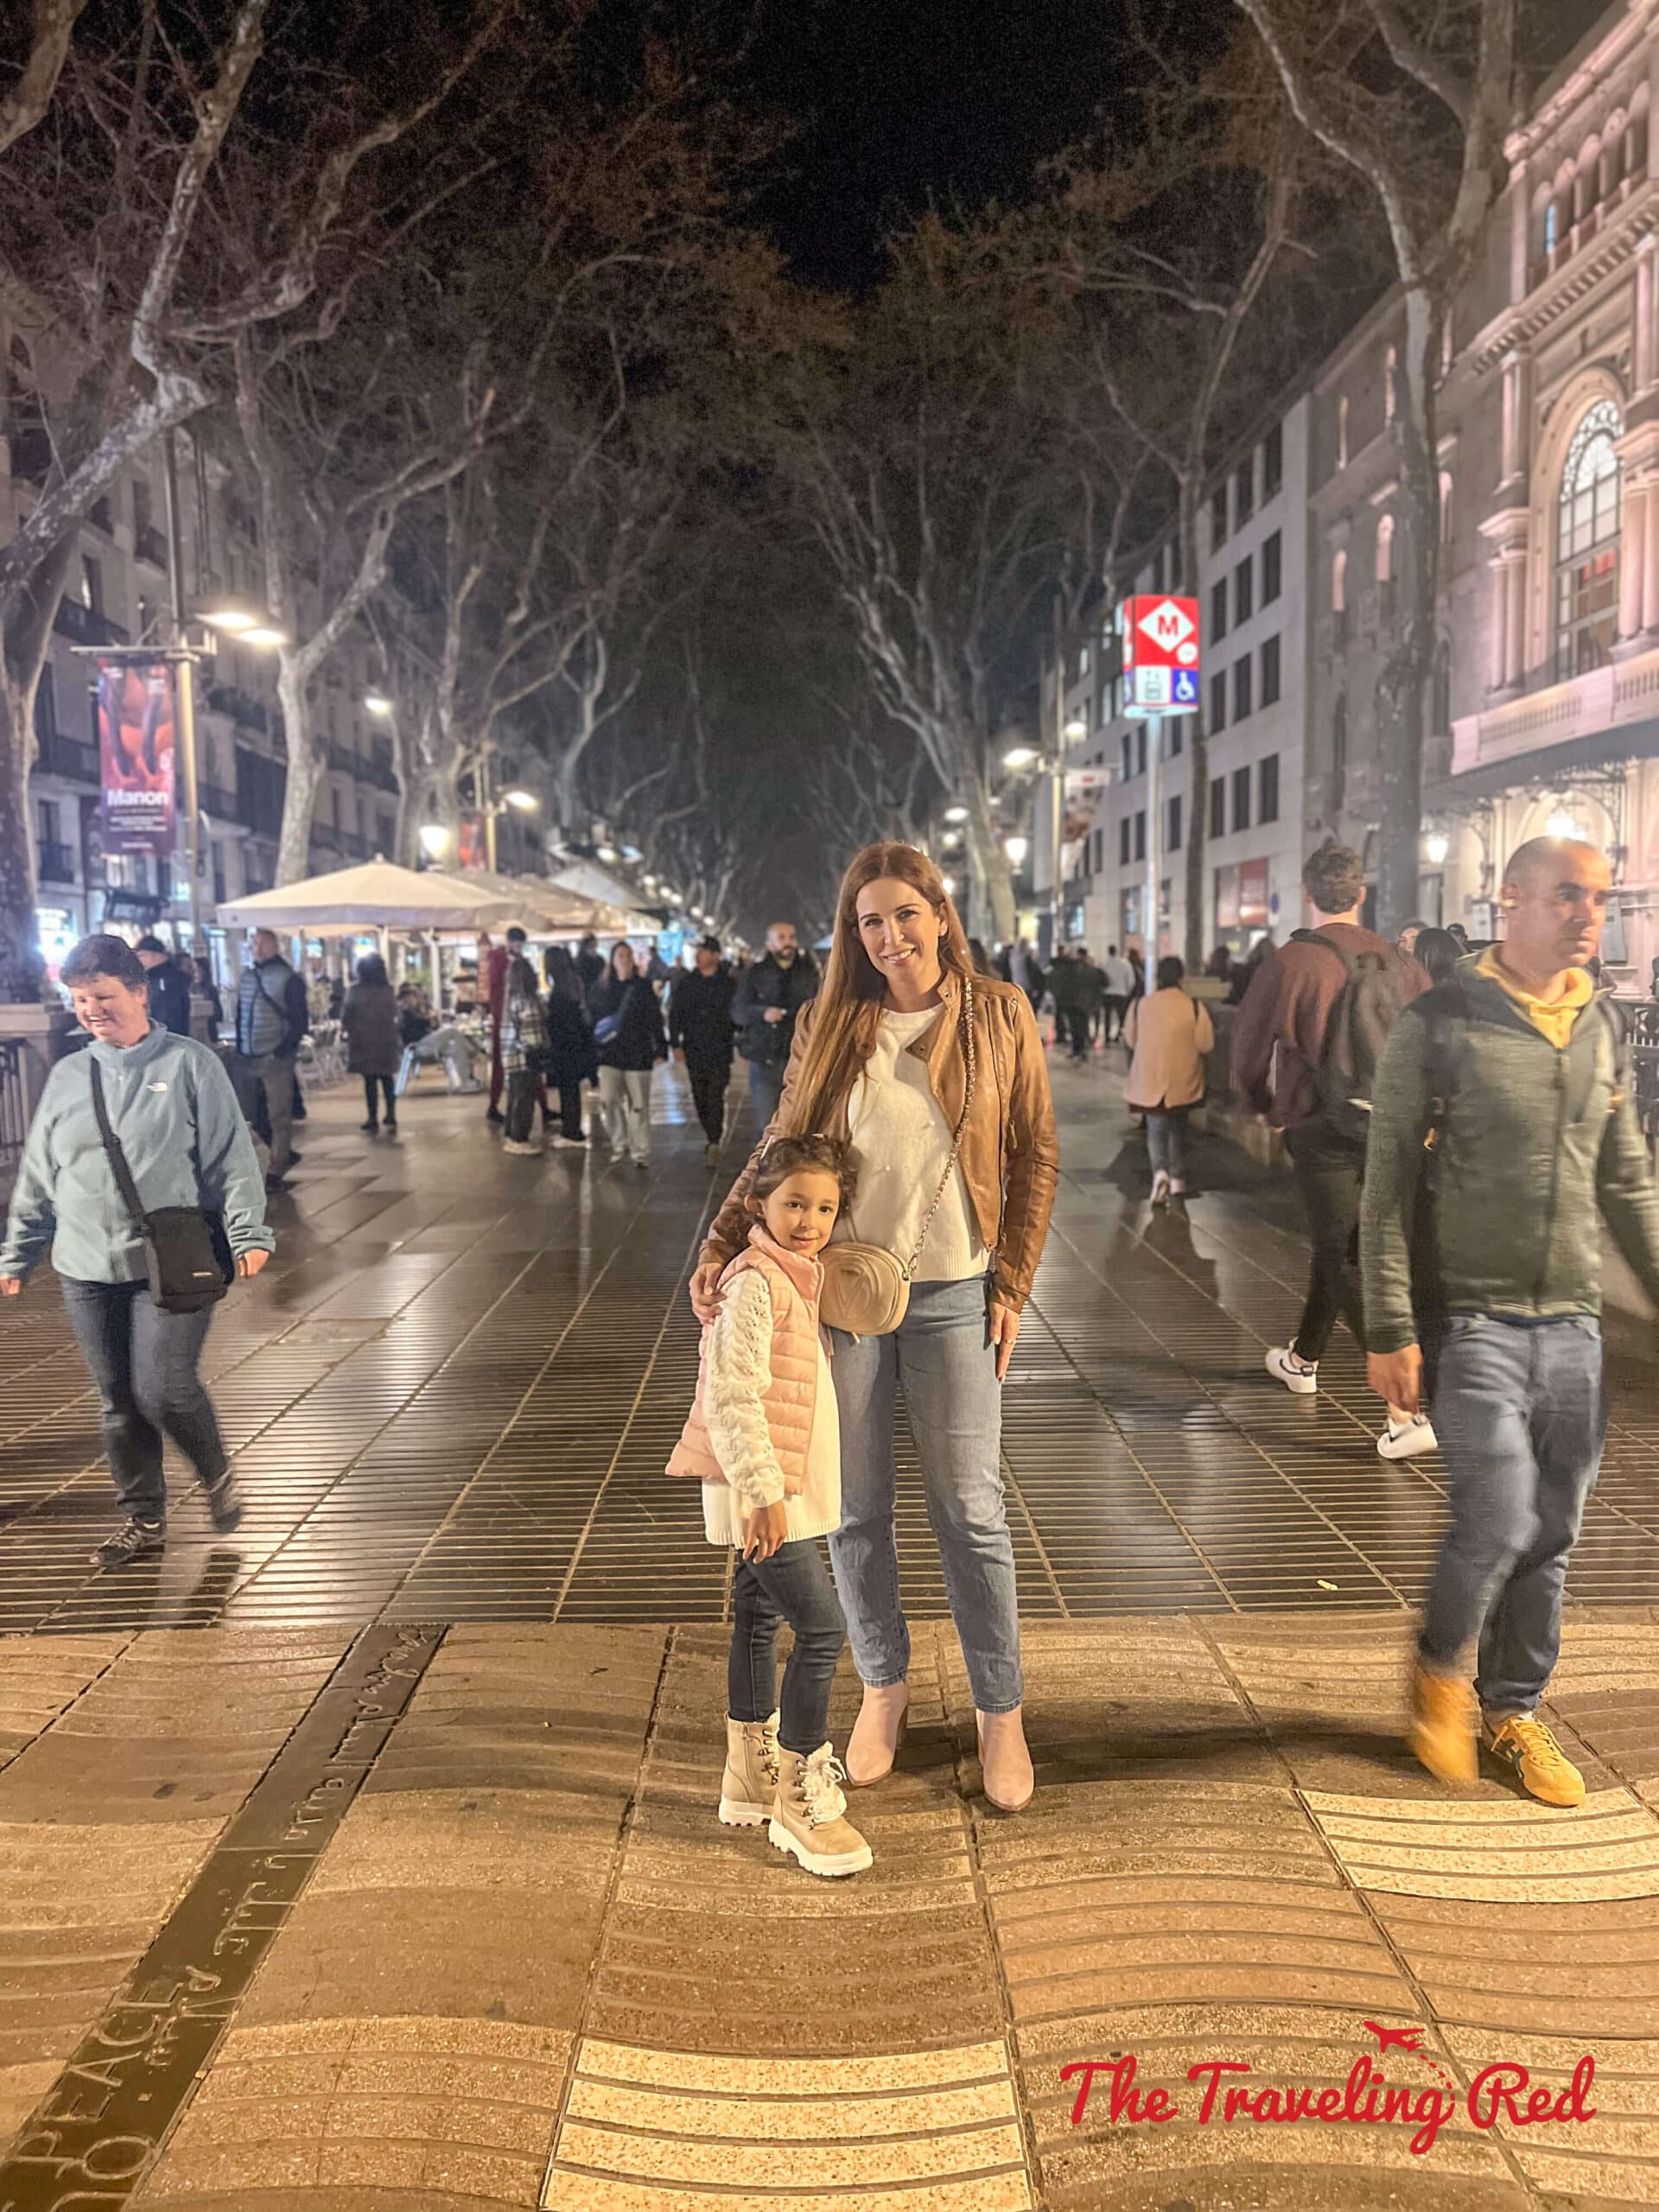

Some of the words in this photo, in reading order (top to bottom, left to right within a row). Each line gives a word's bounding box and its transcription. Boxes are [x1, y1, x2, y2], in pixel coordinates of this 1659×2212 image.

[1157, 614, 1179, 637] M
[107, 788, 168, 807] Manon
[10, 1981, 184, 2165] PEACE
